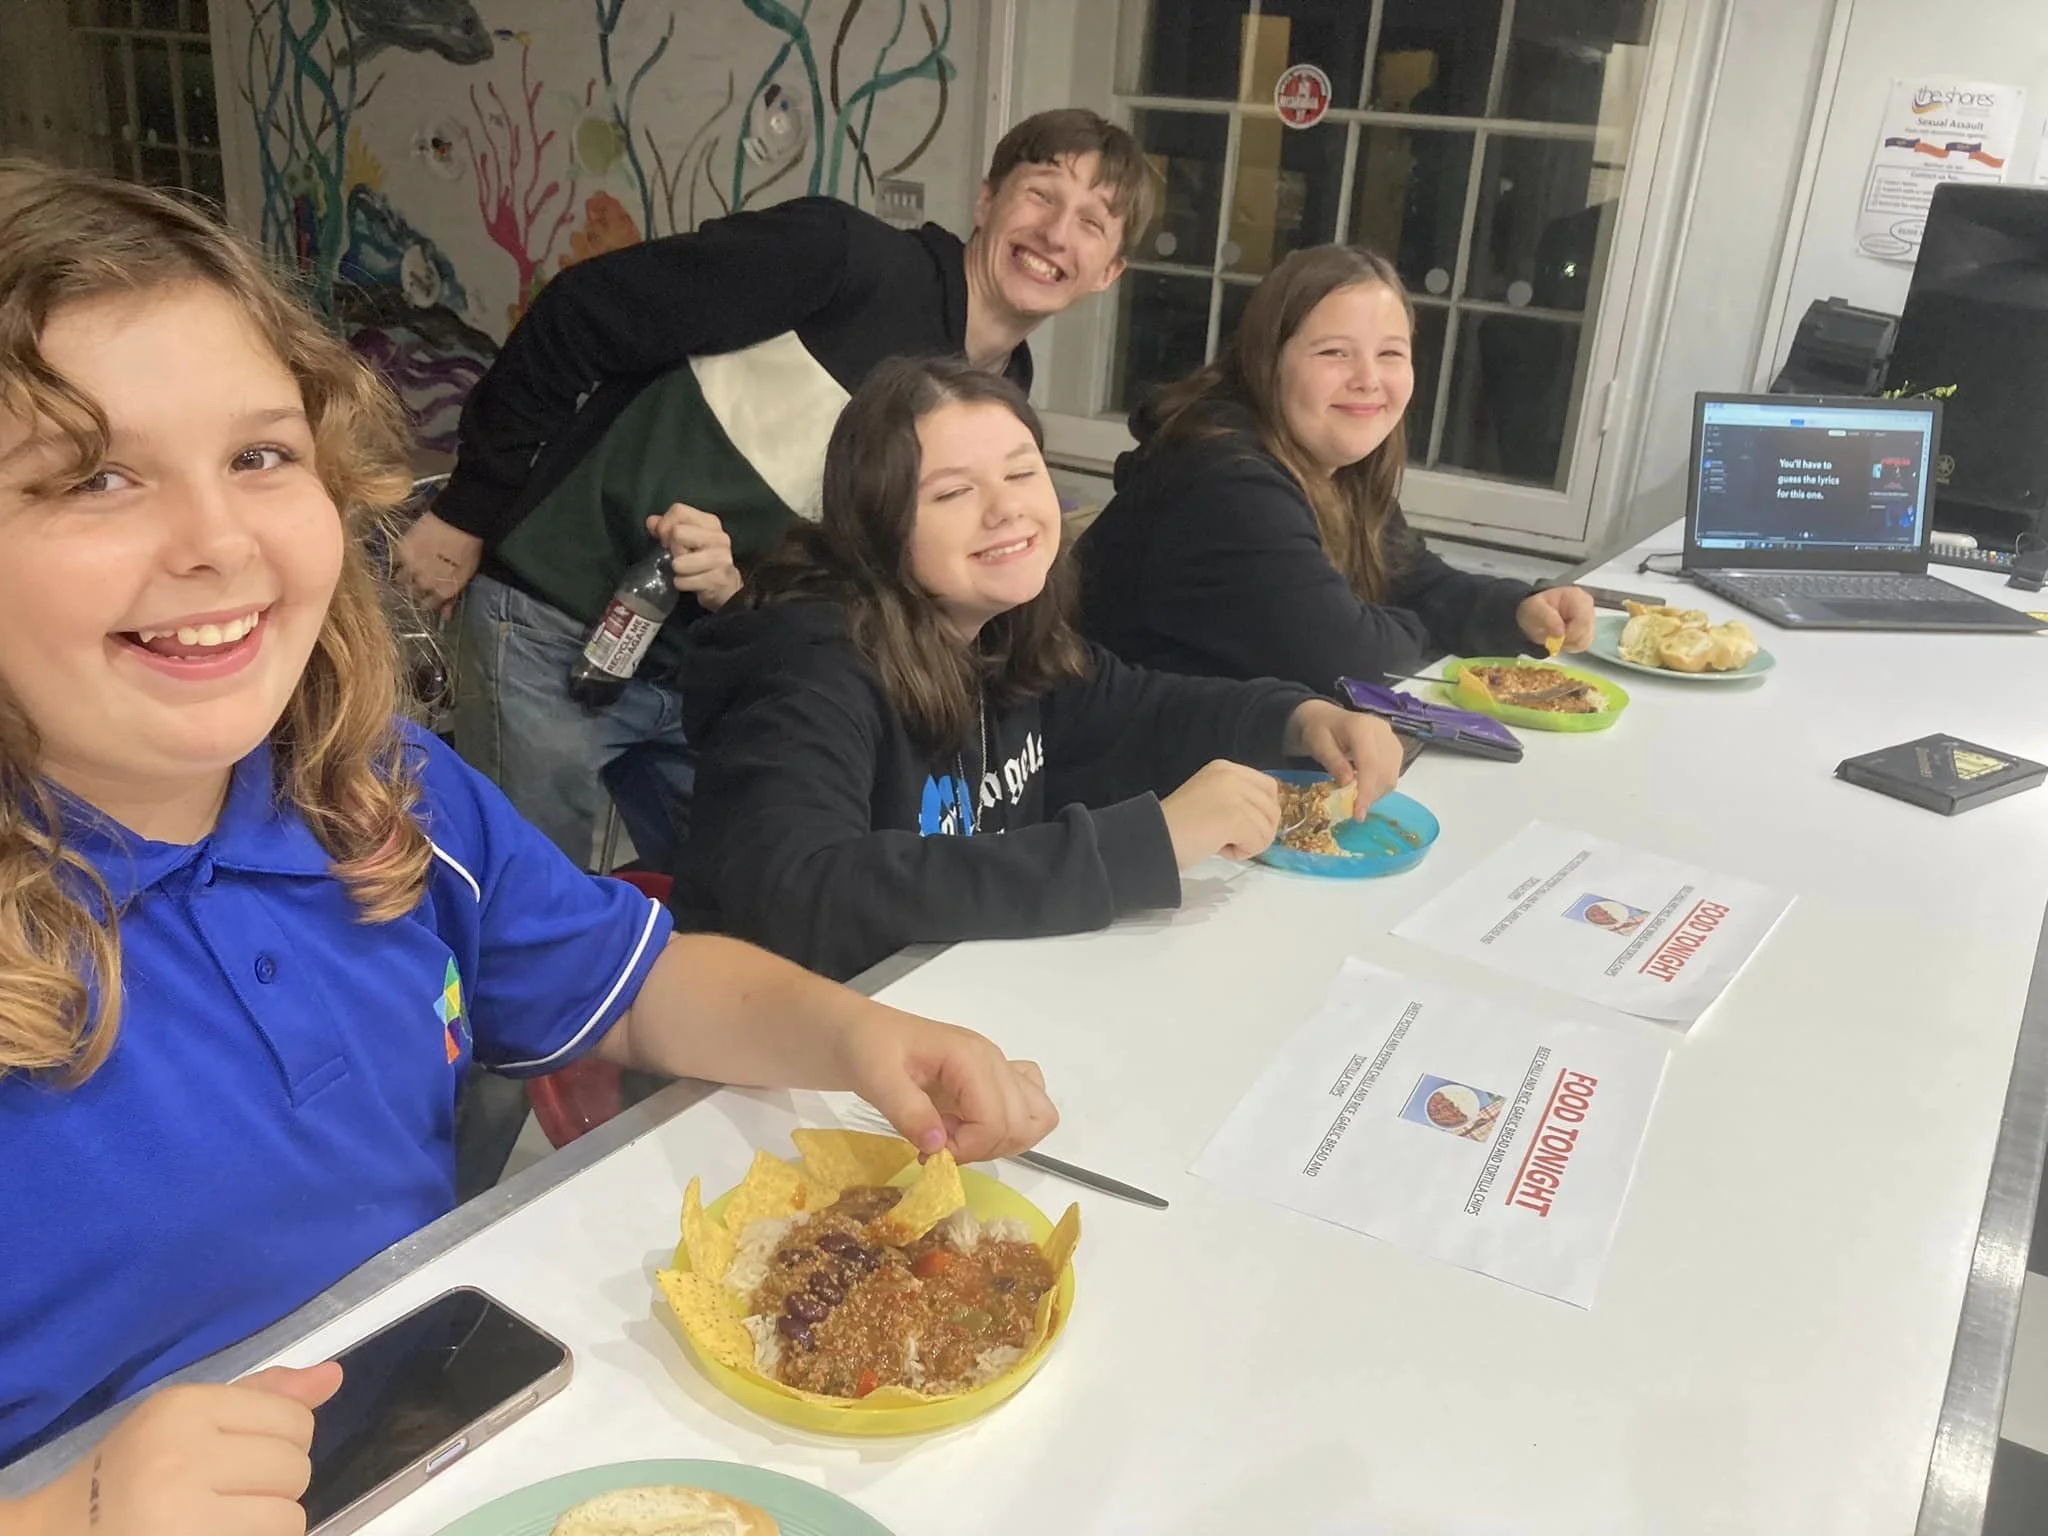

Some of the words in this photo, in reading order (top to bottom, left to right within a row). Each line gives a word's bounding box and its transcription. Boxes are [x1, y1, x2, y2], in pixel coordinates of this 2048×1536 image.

[1917, 85, 1942, 103] the
[1945, 86, 1994, 106] shores
[1917, 116, 1948, 128] Sexual
[1949, 119, 1984, 131] Assault
[1779, 458, 1801, 469] You'll
[1803, 459, 1822, 470] have
[1823, 460, 1832, 470] to
[1777, 475, 1801, 485] guess
[1803, 474, 1817, 485] the
[1818, 474, 1840, 487] lyrics
[1776, 488, 1789, 499] for
[1790, 488, 1805, 499] this
[1806, 491, 1824, 500] one.
[607, 634, 634, 671] RECYCLE
[630, 619, 643, 634] ME
[628, 622, 651, 655] AGAIN
[1688, 901, 1729, 932] FOOD
[1645, 929, 1707, 982] TONIGHT
[1384, 1038, 1400, 1050] AND
[1343, 1055, 1368, 1079] TORTILLA
[1372, 1050, 1392, 1071] PEPPER
[1528, 1059, 1546, 1077] CHILLI
[1331, 1079, 1350, 1097] CHIPS
[1361, 1069, 1380, 1088] CHILLI
[1523, 1076, 1538, 1090] AND
[1352, 1086, 1369, 1102] AND
[1552, 1072, 1598, 1123] FOOD
[1506, 1105, 1525, 1127] GARLIC
[1497, 1126, 1515, 1149] BREAD
[1314, 1137, 1337, 1162] BREAD
[1490, 1147, 1505, 1163] AND
[1305, 1159, 1323, 1177] AND
[1476, 1162, 1499, 1193] TORTILLA
[1516, 1125, 1578, 1217] TONIGHT
[1466, 1192, 1485, 1216] CHIPS
